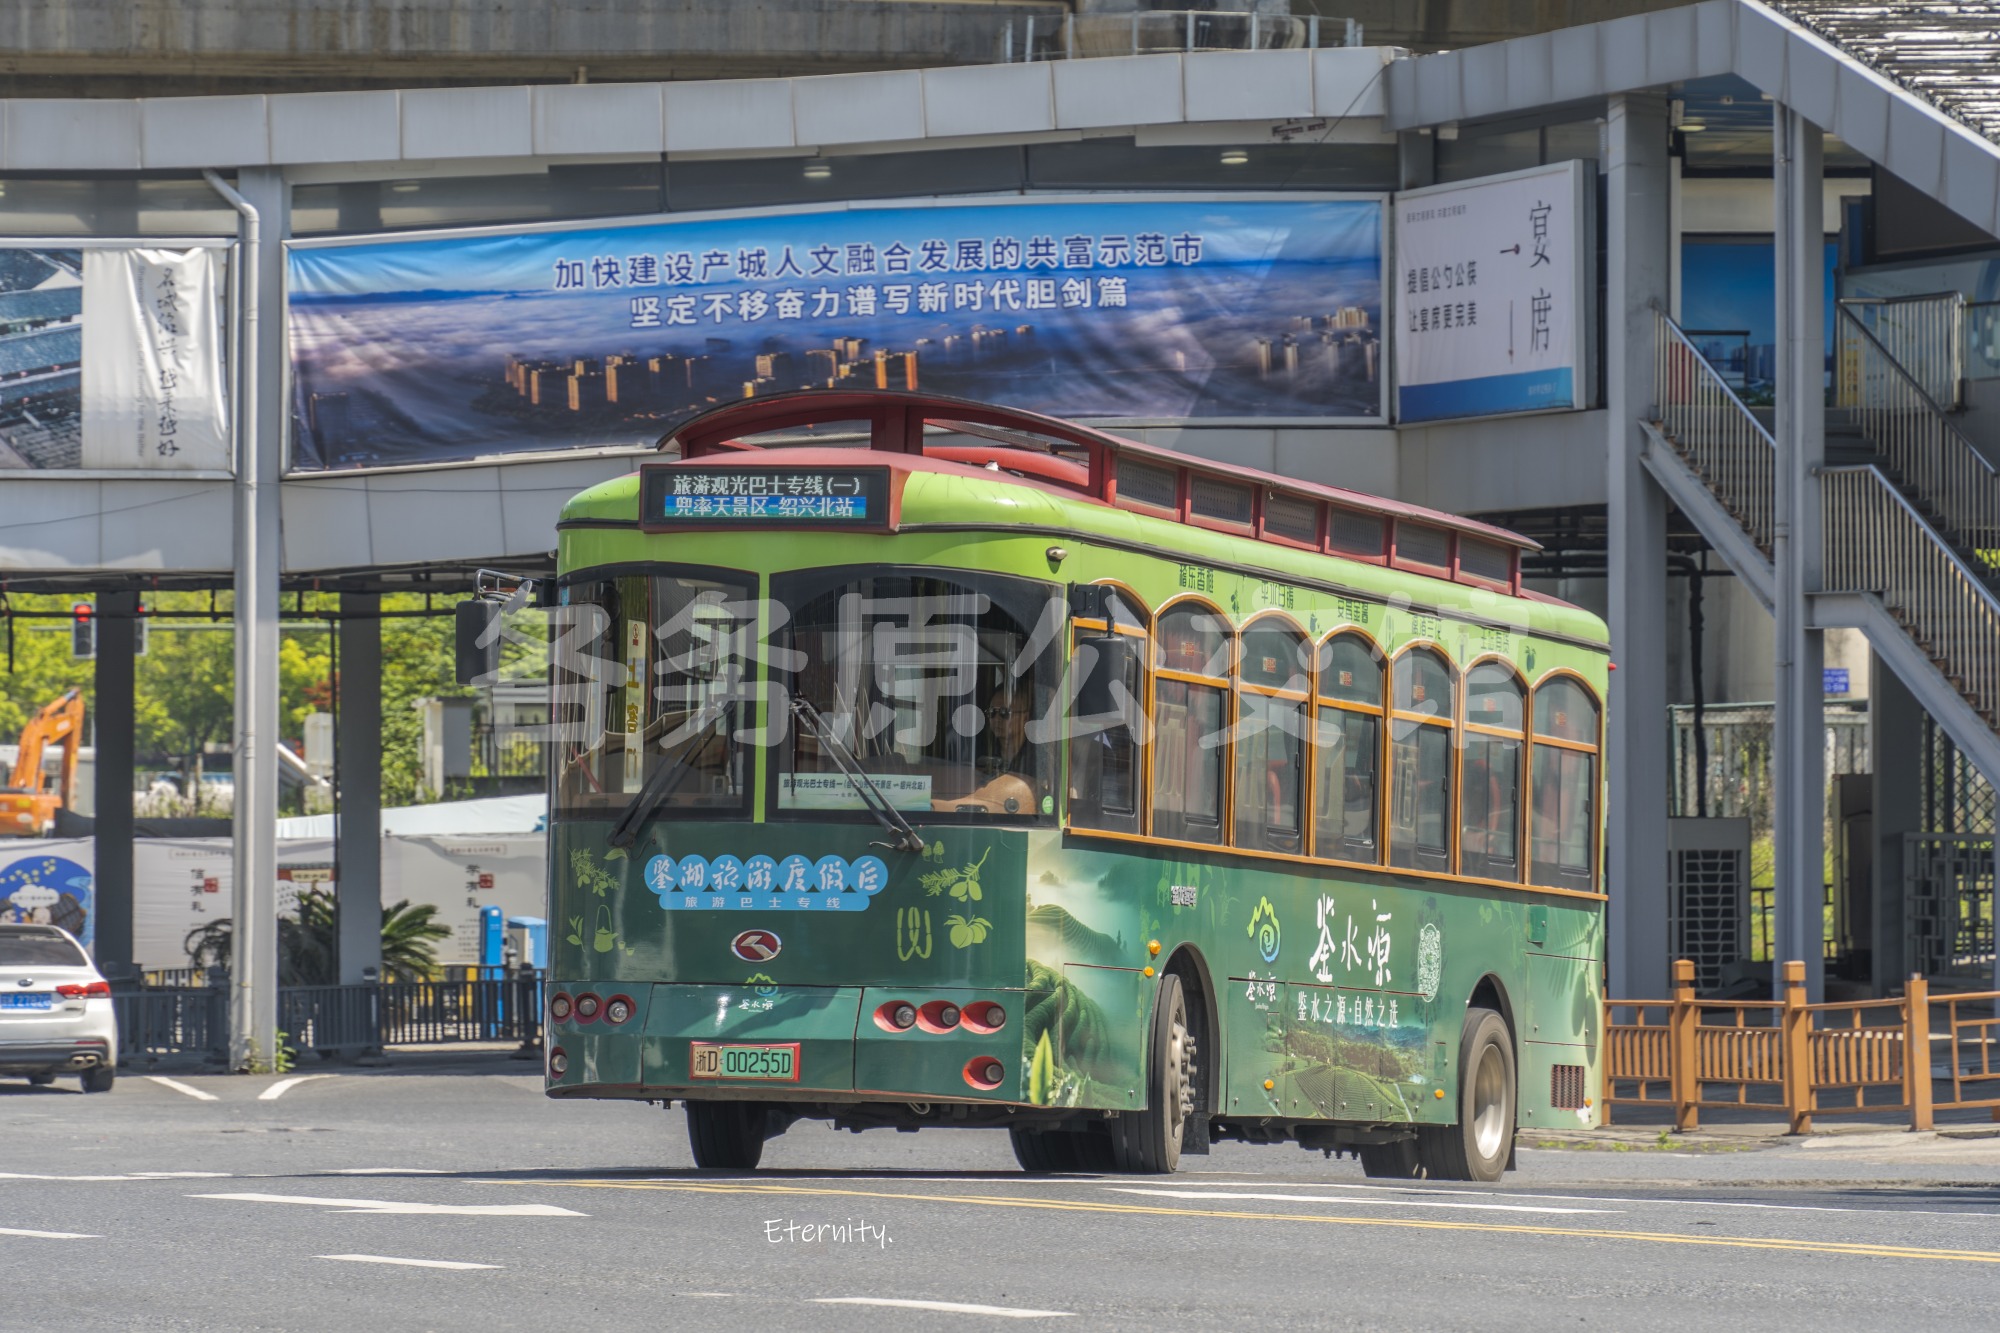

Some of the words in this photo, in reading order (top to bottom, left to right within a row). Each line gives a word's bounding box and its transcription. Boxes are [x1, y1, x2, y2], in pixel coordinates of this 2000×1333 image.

[555, 233, 1203, 291] 加快建设产城人文融合发展的共富示范市
[630, 277, 1128, 328] 坚定不移奋力谱写新时代胆剑篇
[673, 475, 861, 496] 旅游观光巴士专线(一)
[684, 897, 841, 909] 旅游巴士专线
